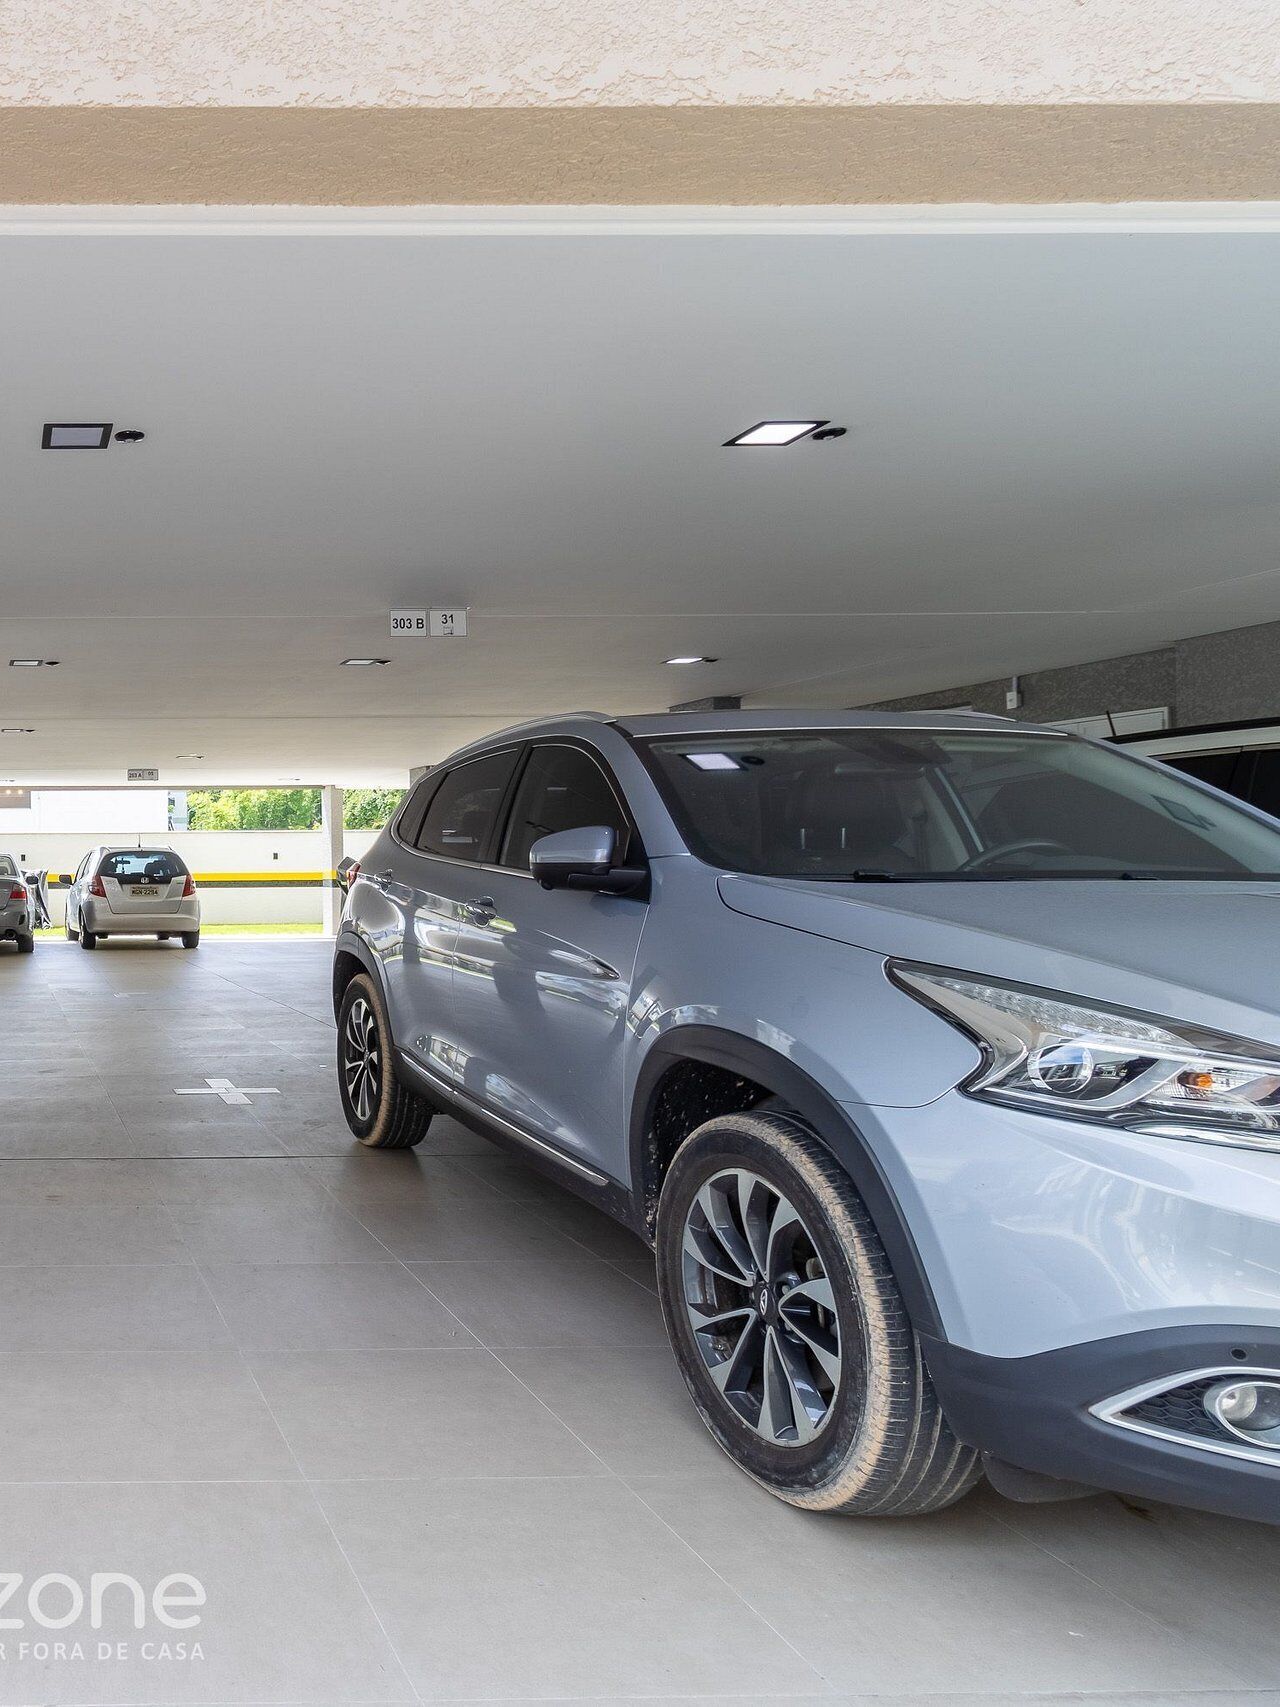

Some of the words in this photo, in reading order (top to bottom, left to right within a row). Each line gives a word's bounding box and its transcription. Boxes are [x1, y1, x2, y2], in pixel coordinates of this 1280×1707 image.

[392, 617, 413, 630] 303
[416, 617, 425, 630] B
[441, 613, 454, 625] 31
